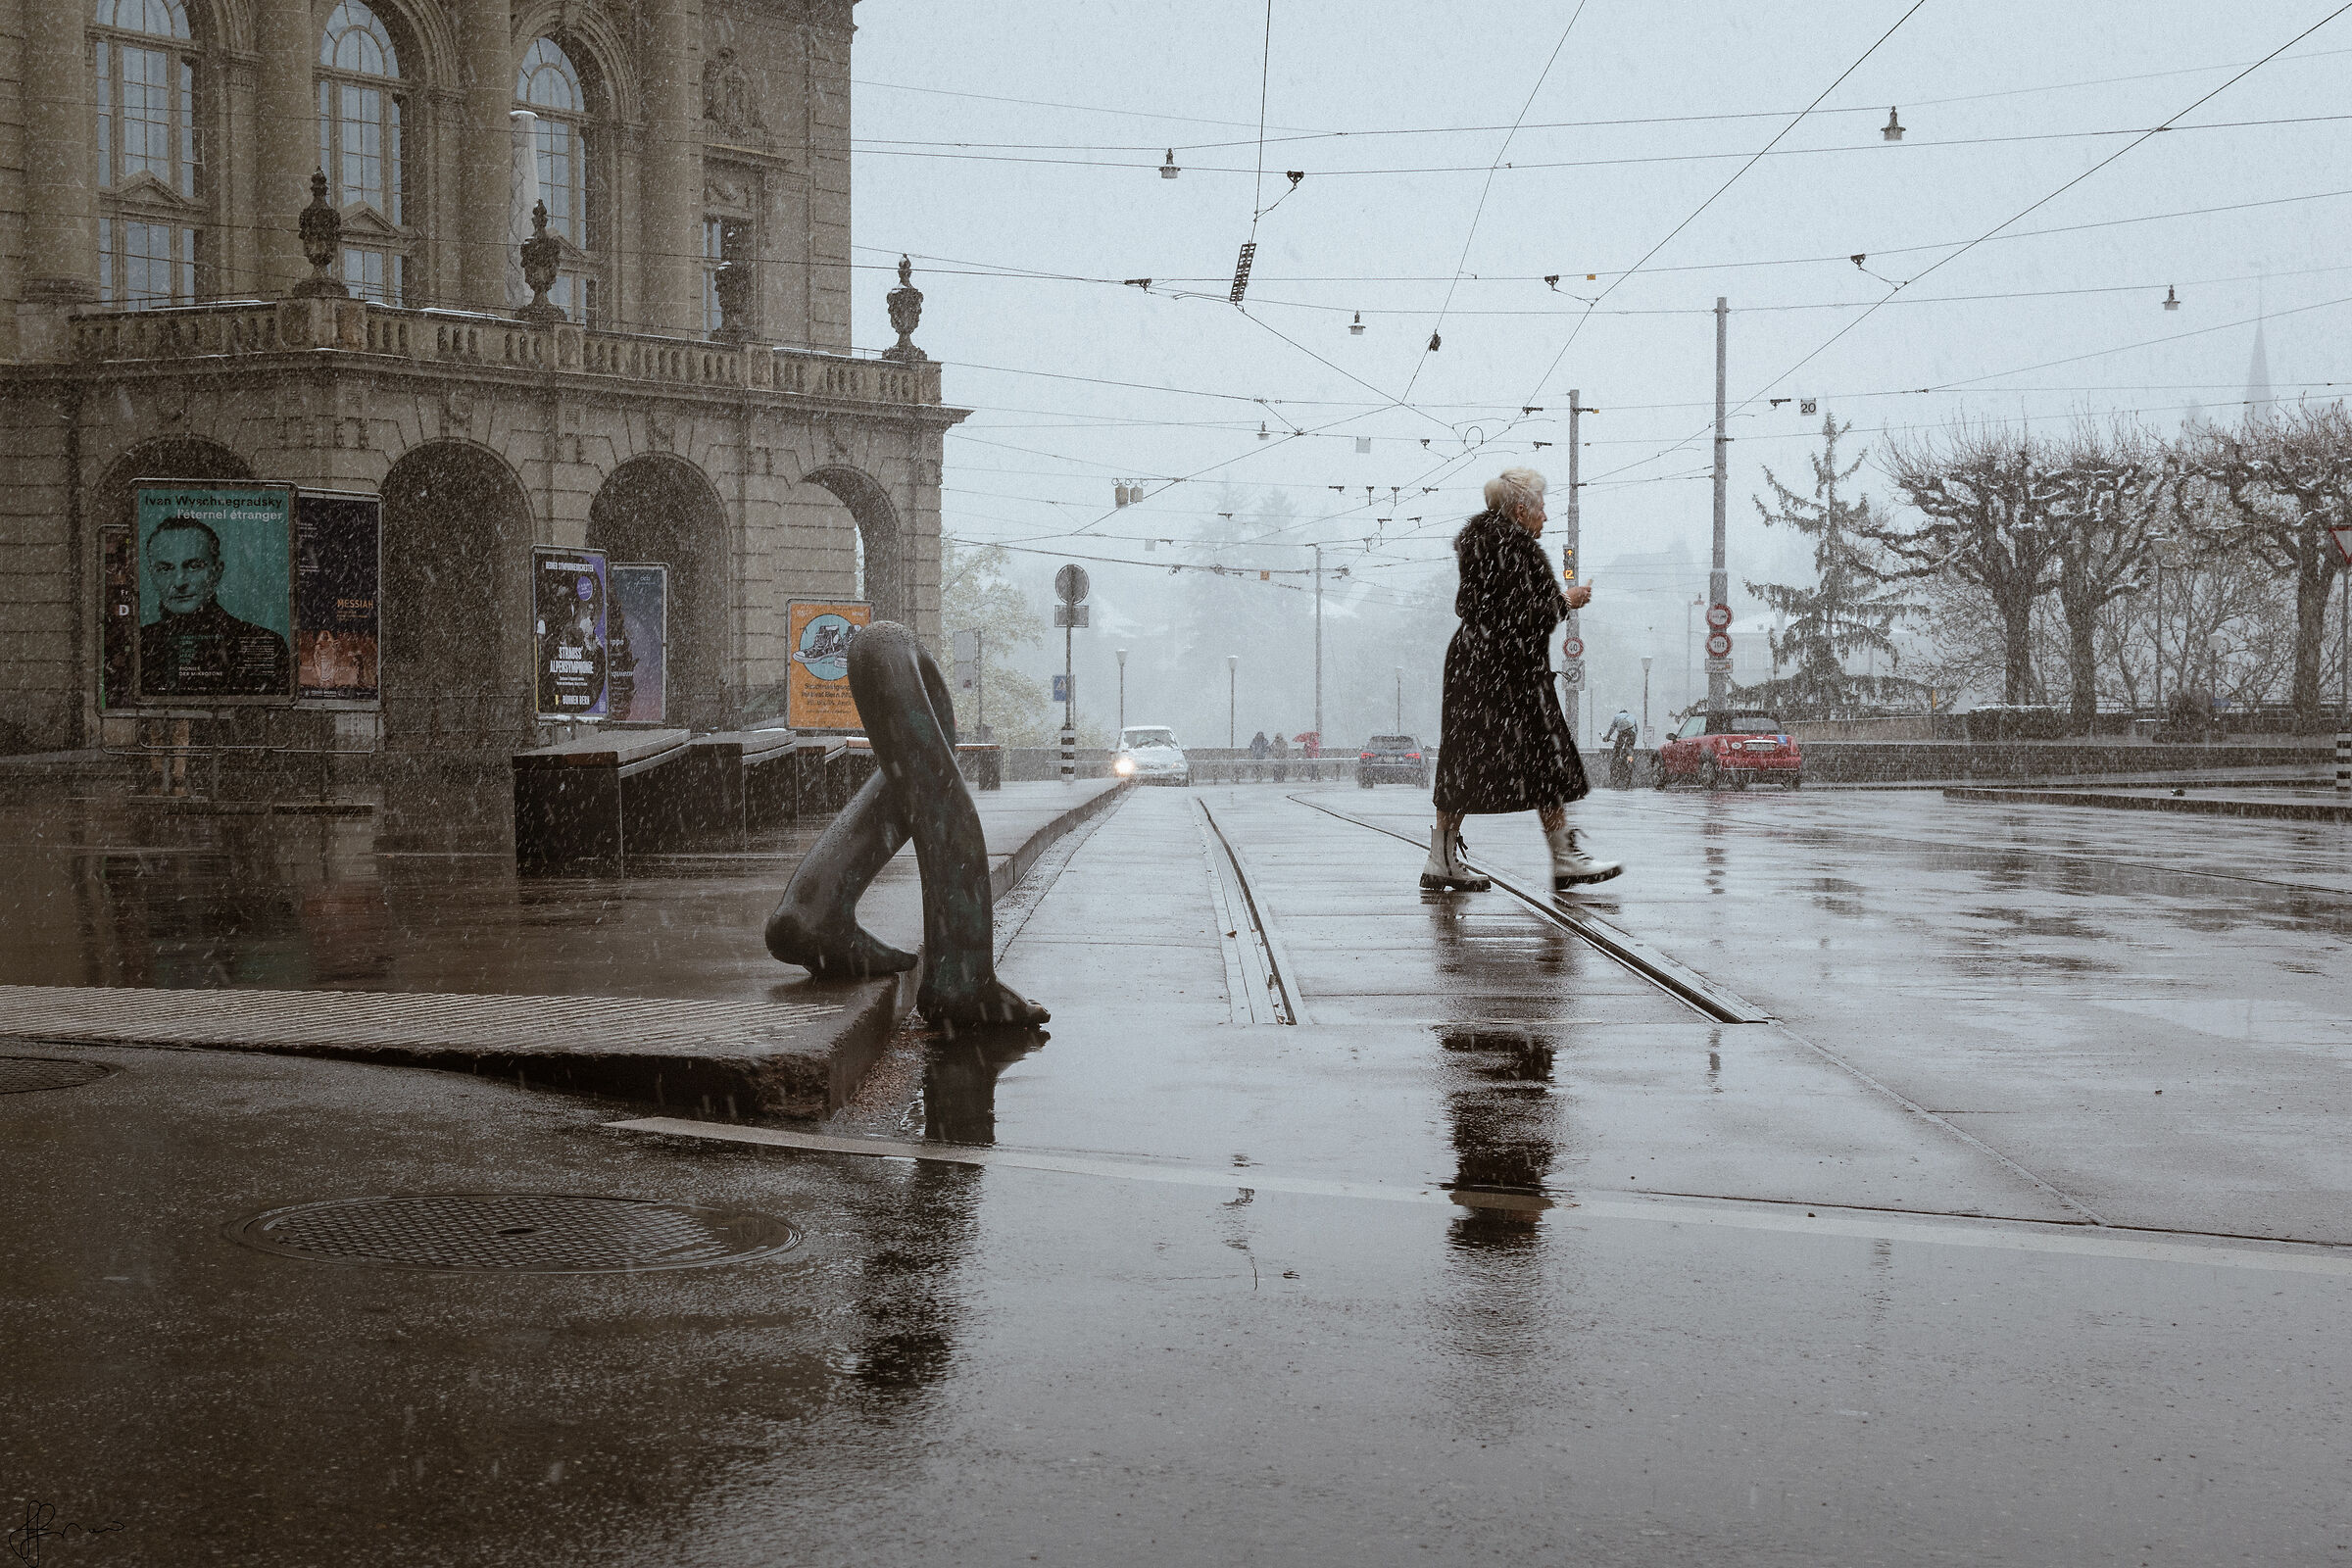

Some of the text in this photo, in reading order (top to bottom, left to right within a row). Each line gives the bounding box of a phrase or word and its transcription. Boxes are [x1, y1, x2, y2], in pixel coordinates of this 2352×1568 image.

[1800, 403, 1816, 414] 20
[145, 495, 172, 507] Ivan
[230, 509, 283, 521] étranger
[336, 599, 374, 609] MESSIAH
[1568, 643, 1578, 652] 40
